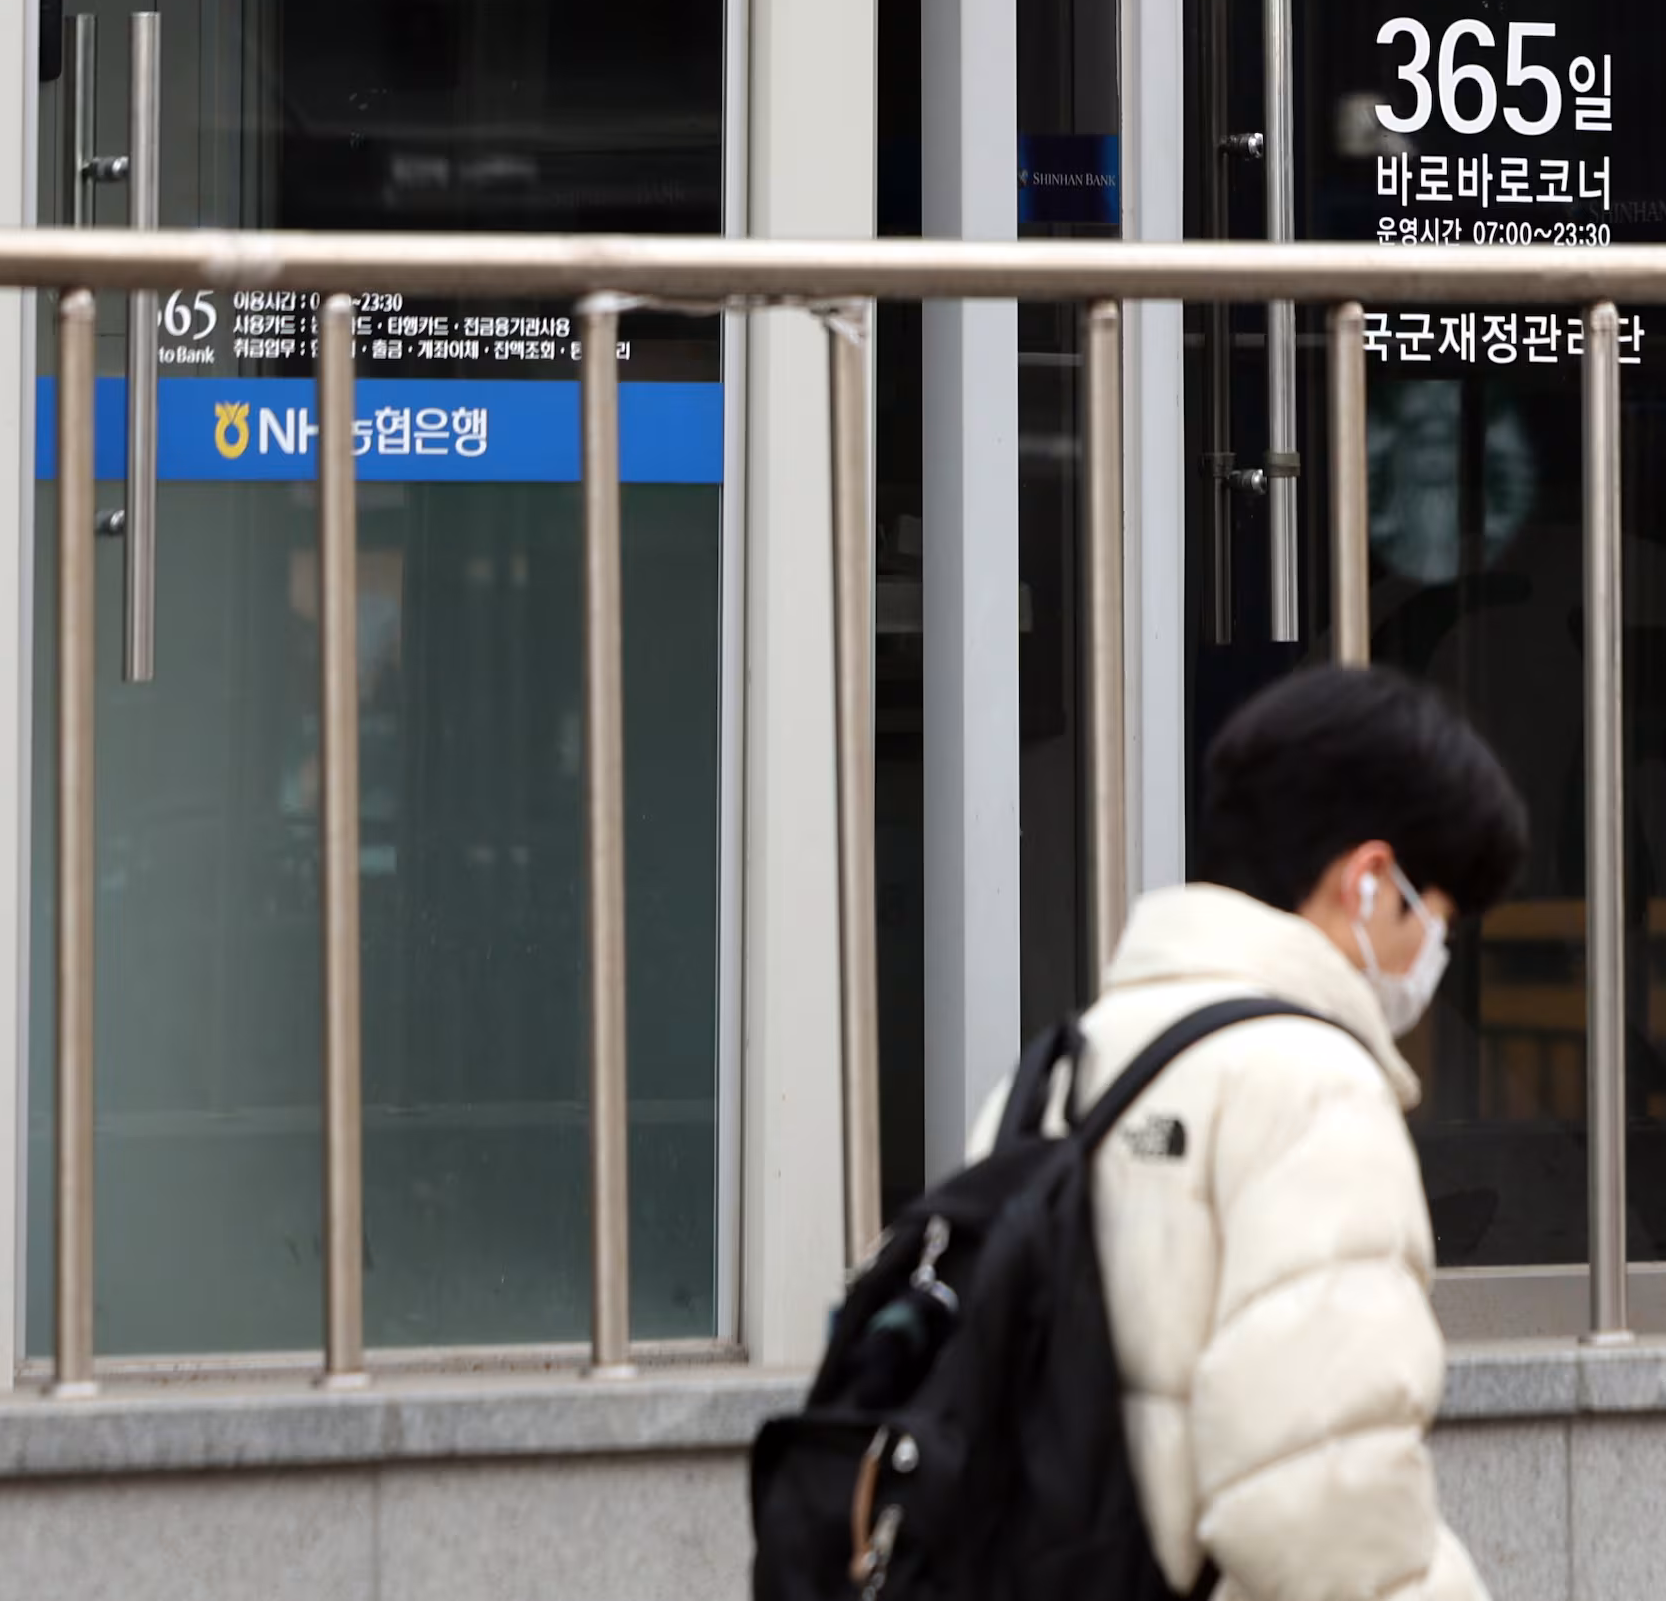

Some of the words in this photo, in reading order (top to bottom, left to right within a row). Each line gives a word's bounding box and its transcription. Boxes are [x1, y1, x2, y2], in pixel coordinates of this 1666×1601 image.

[1033, 171, 1083, 187] SHINHAN
[1085, 172, 1116, 187] BANK
[1376, 152, 1611, 211] 바로바로코너
[1376, 216, 1463, 247] 운영시간
[1473, 220, 1611, 247] 07:00~23:30
[157, 288, 218, 341] 65
[176, 345, 215, 364] Bank
